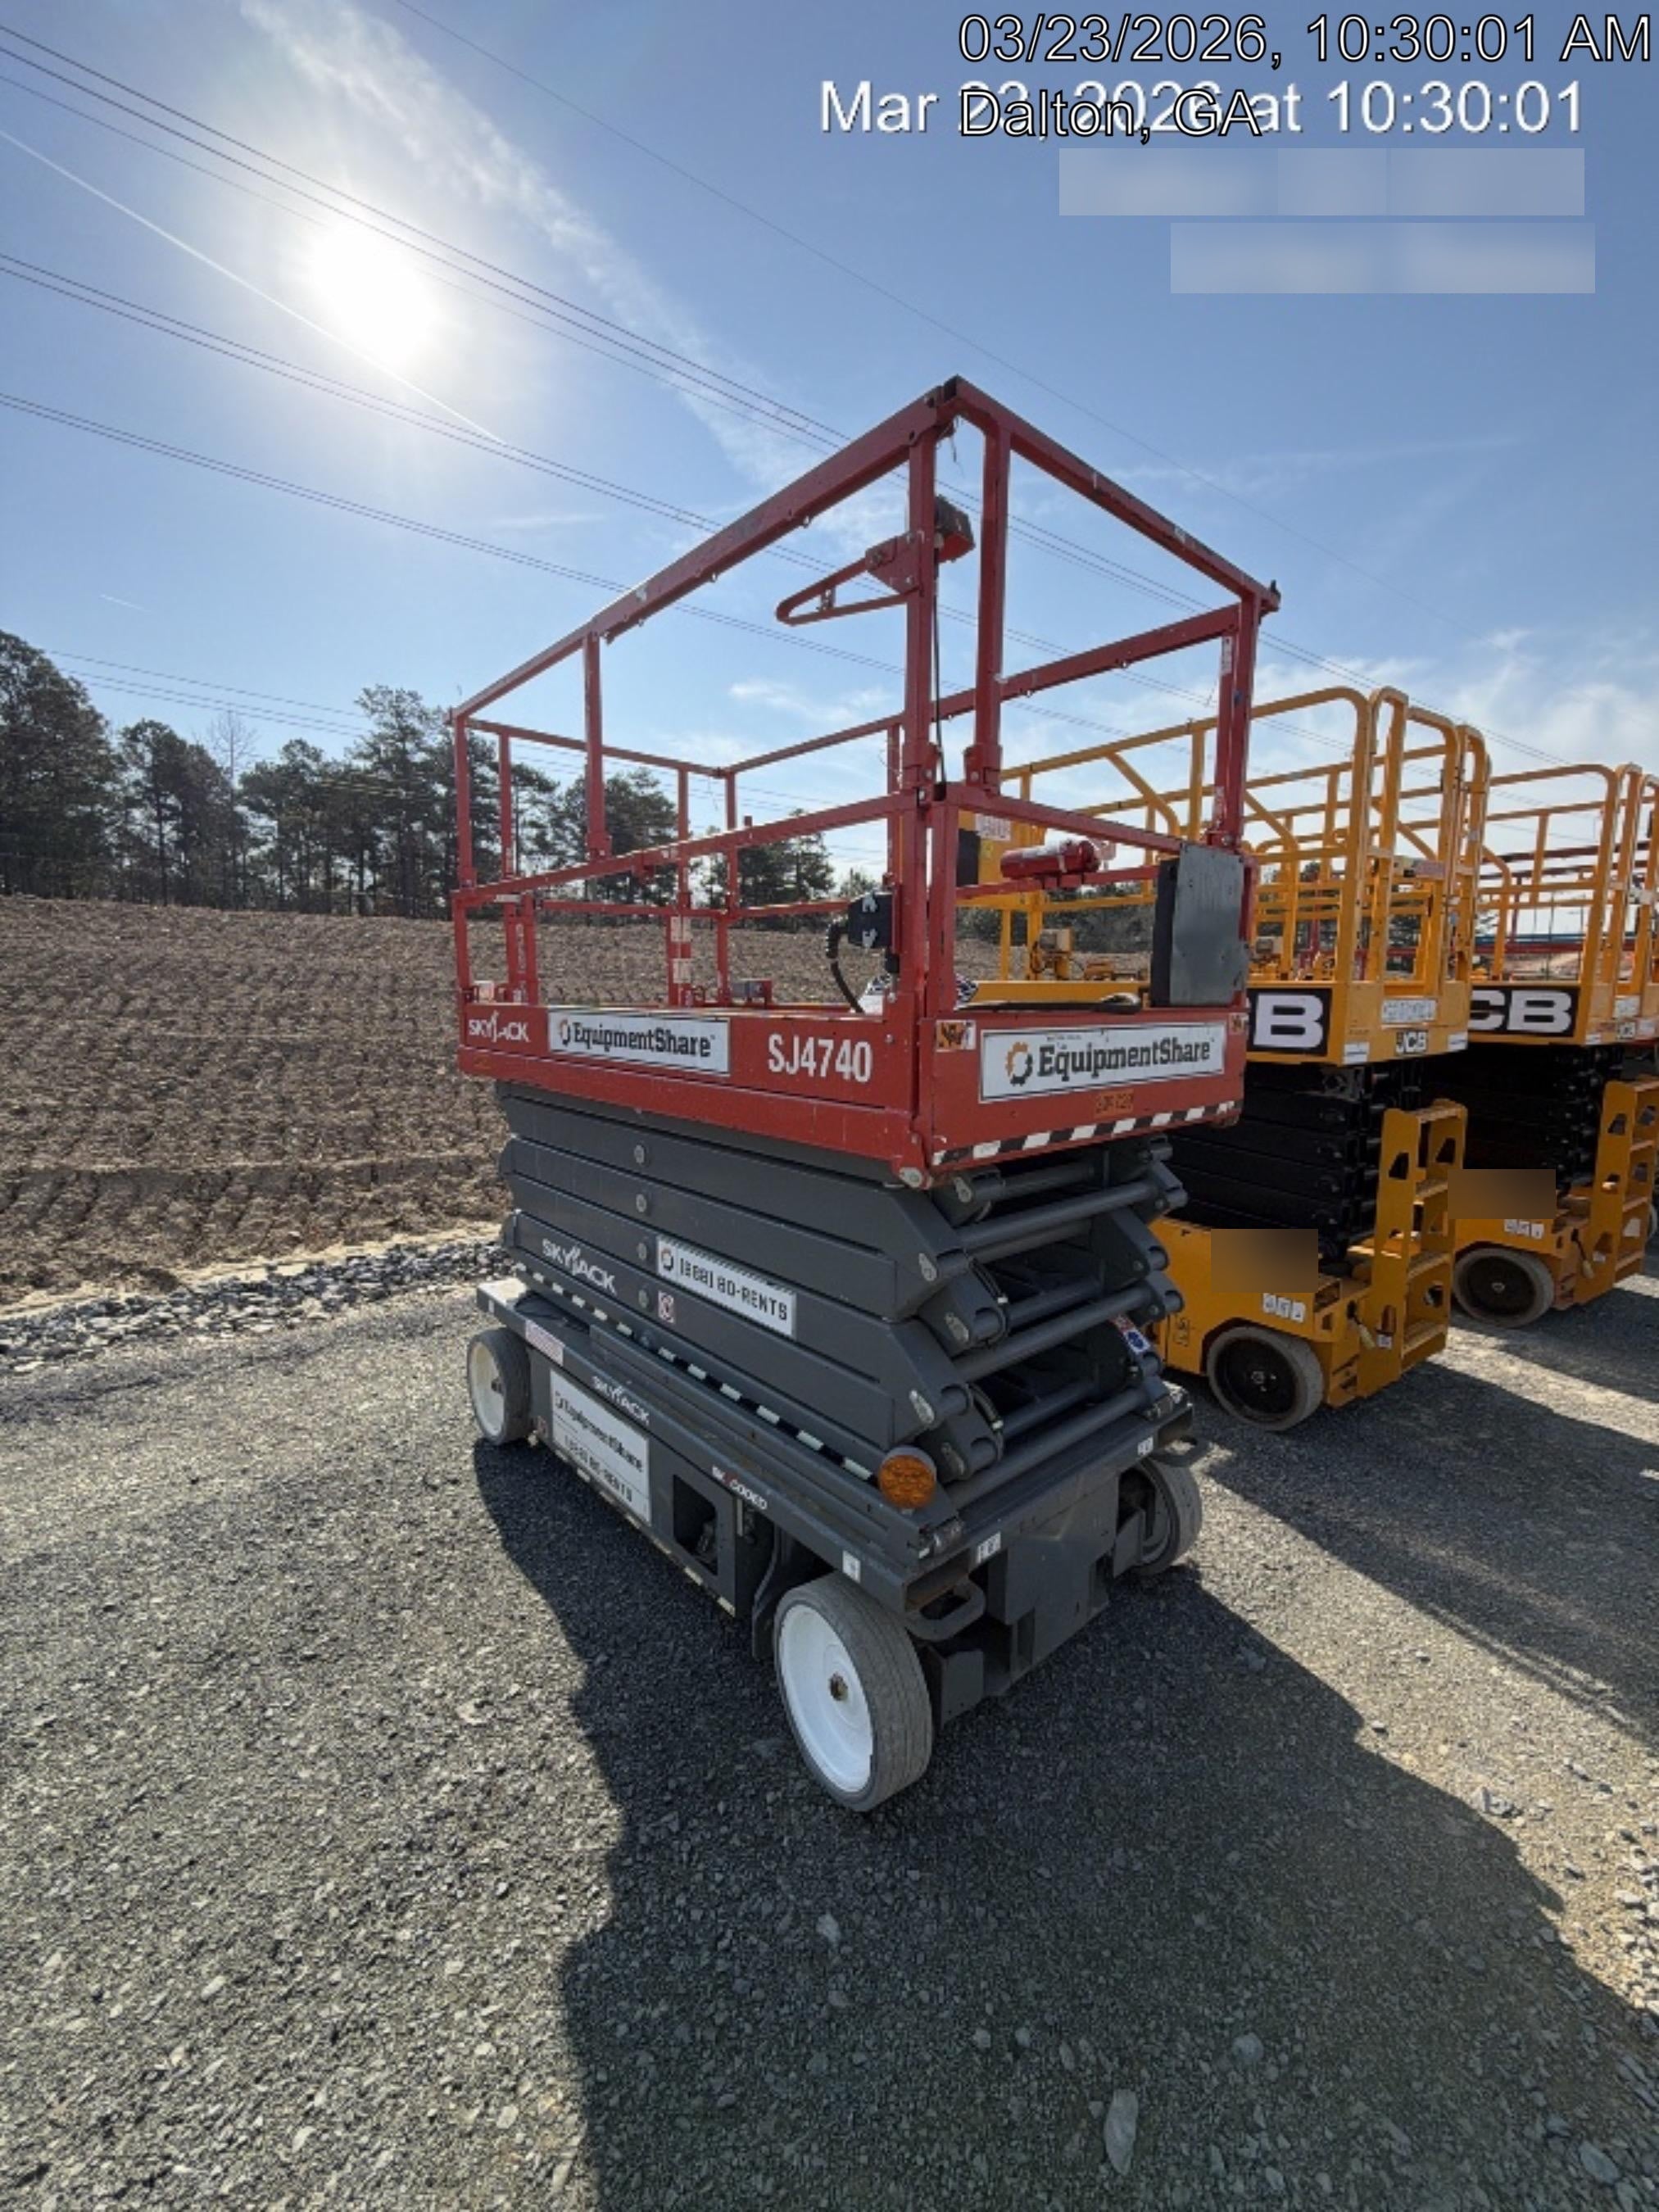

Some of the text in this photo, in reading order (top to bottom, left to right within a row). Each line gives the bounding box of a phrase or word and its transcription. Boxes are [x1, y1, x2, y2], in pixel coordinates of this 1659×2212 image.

[573, 1022, 711, 1058] EquipmentShare
[768, 1033, 872, 1083] SJ4740
[1037, 1038, 1211, 1081] EquipmentShare
[542, 1238, 617, 1295] SKYJACK
